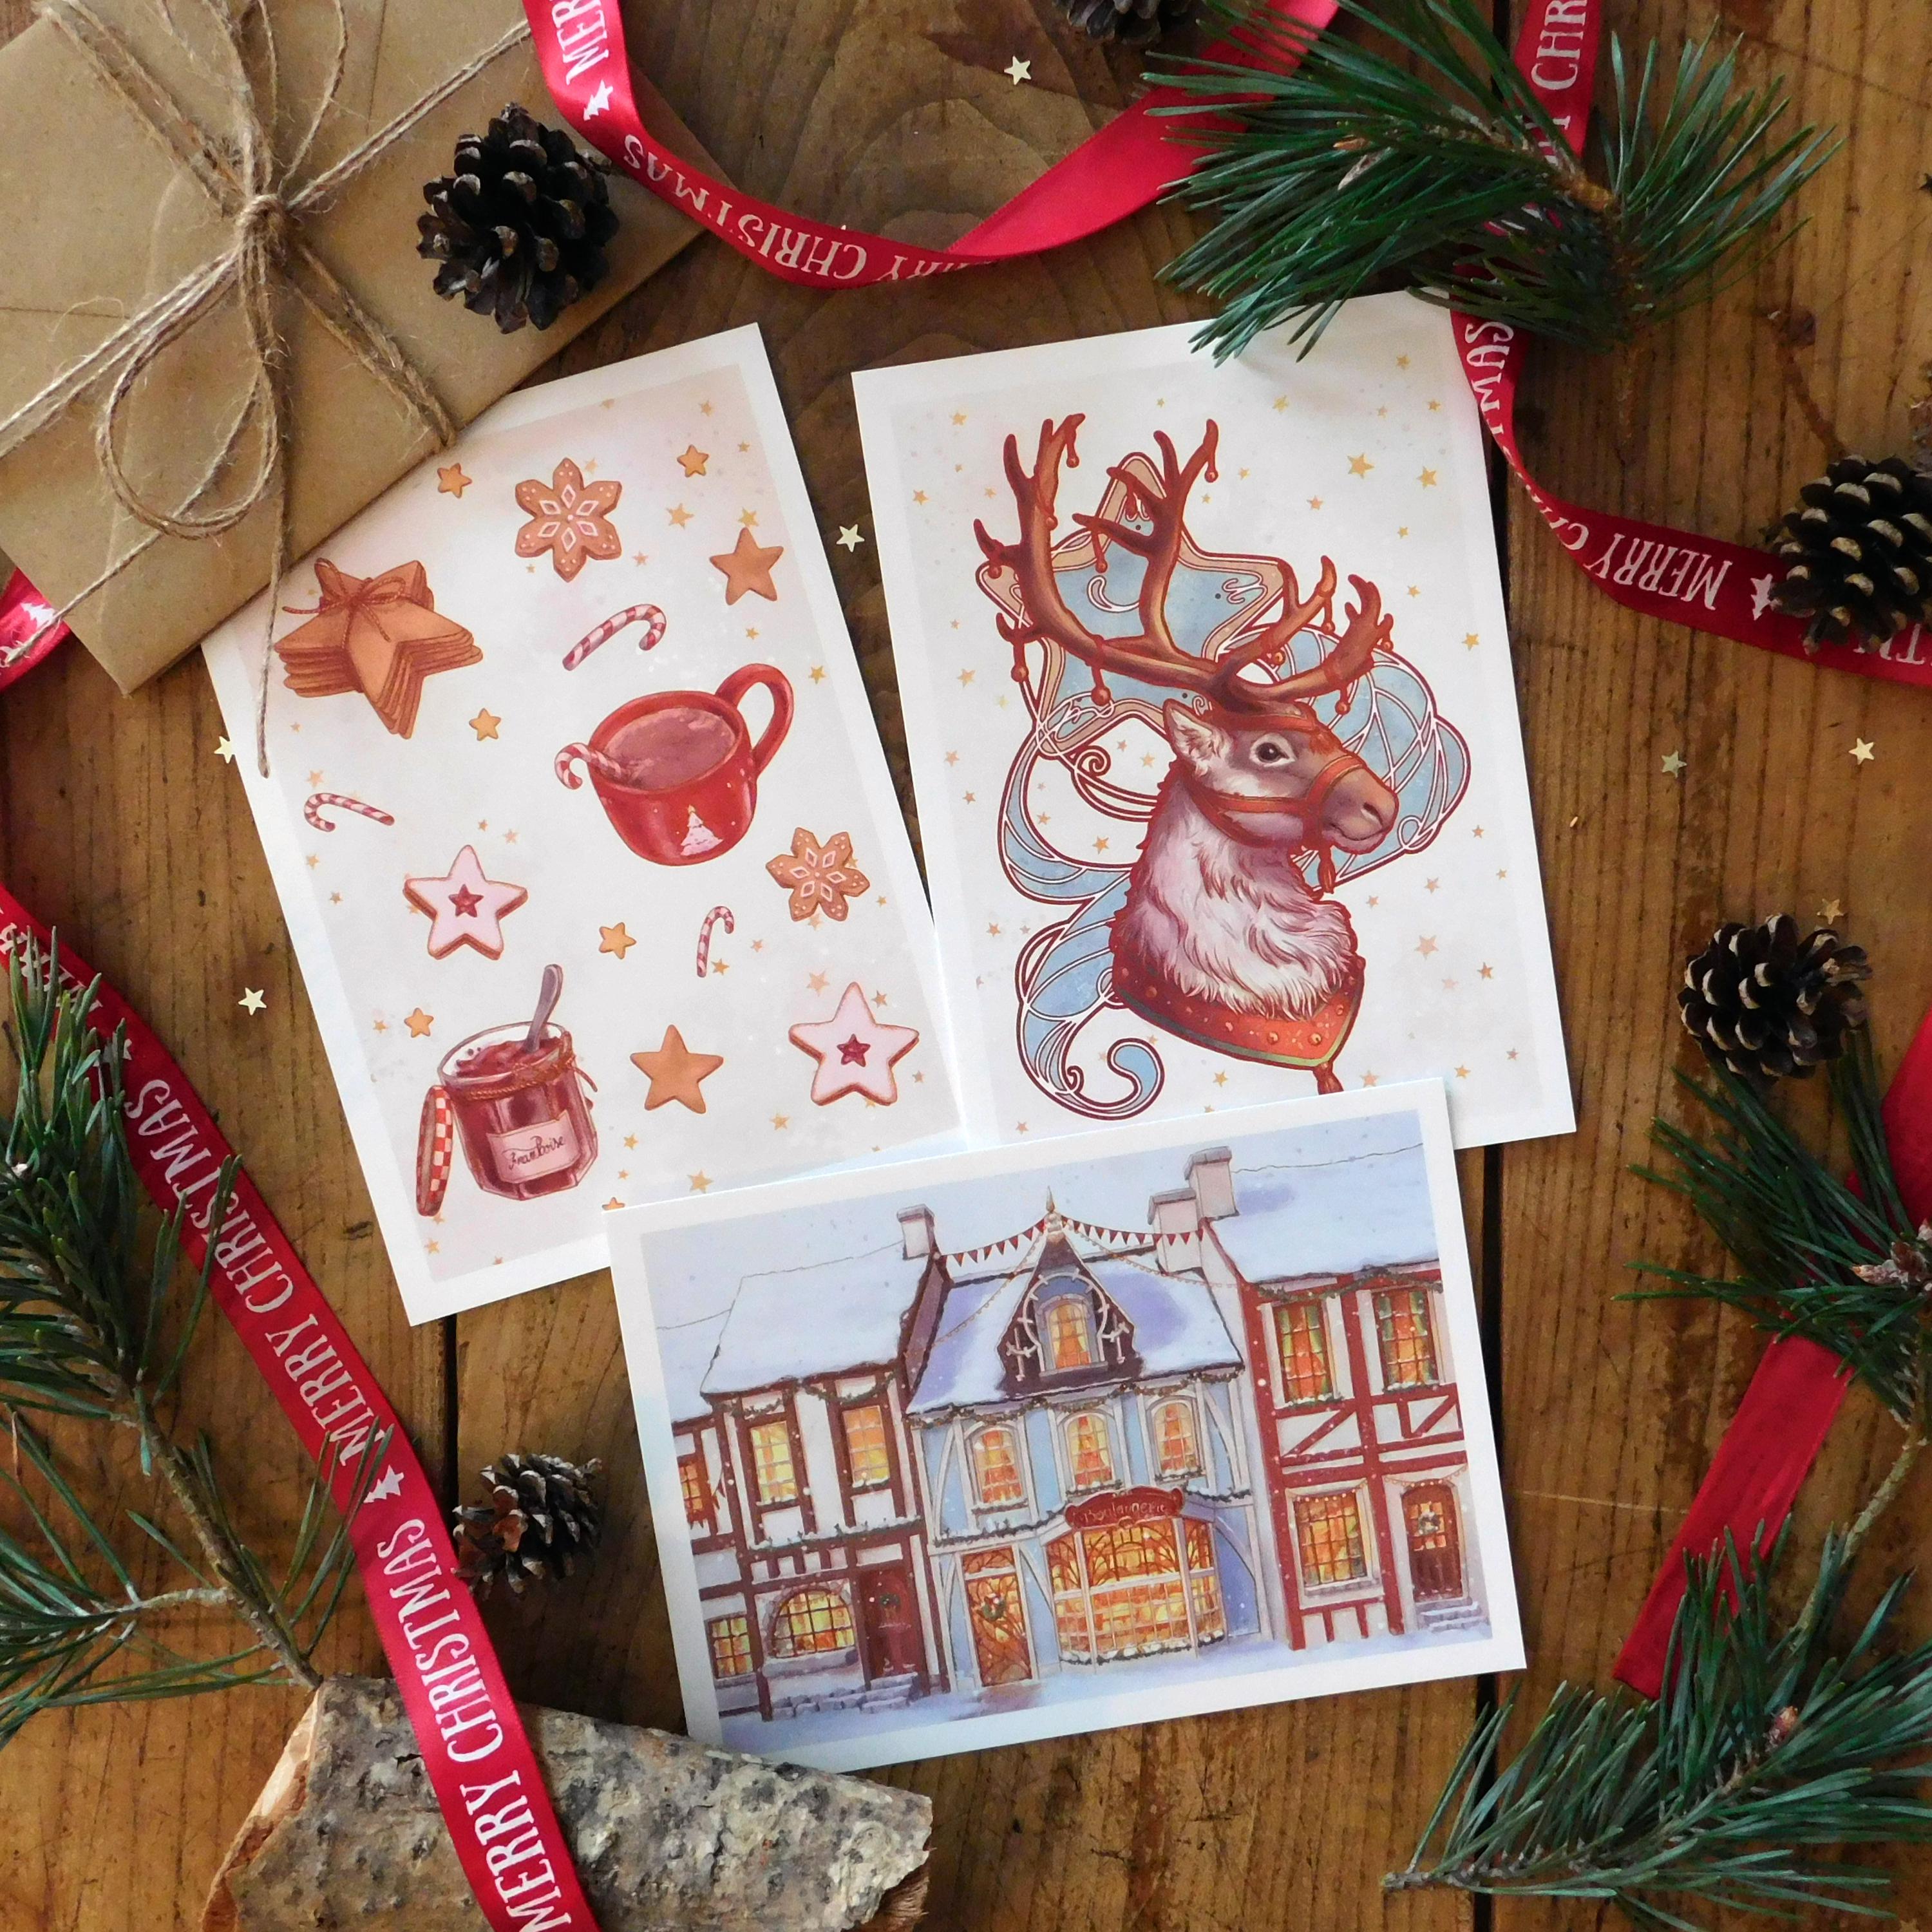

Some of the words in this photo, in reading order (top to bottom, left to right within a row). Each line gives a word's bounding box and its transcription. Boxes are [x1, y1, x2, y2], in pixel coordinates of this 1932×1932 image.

[1582, 532, 1733, 611] MERRY
[124, 1079, 294, 1313] CHRISTMAS
[264, 1312, 386, 1466] MERRY
[377, 1518, 503, 1763] CHRISTMAS
[459, 1769, 572, 1932] MERRY
